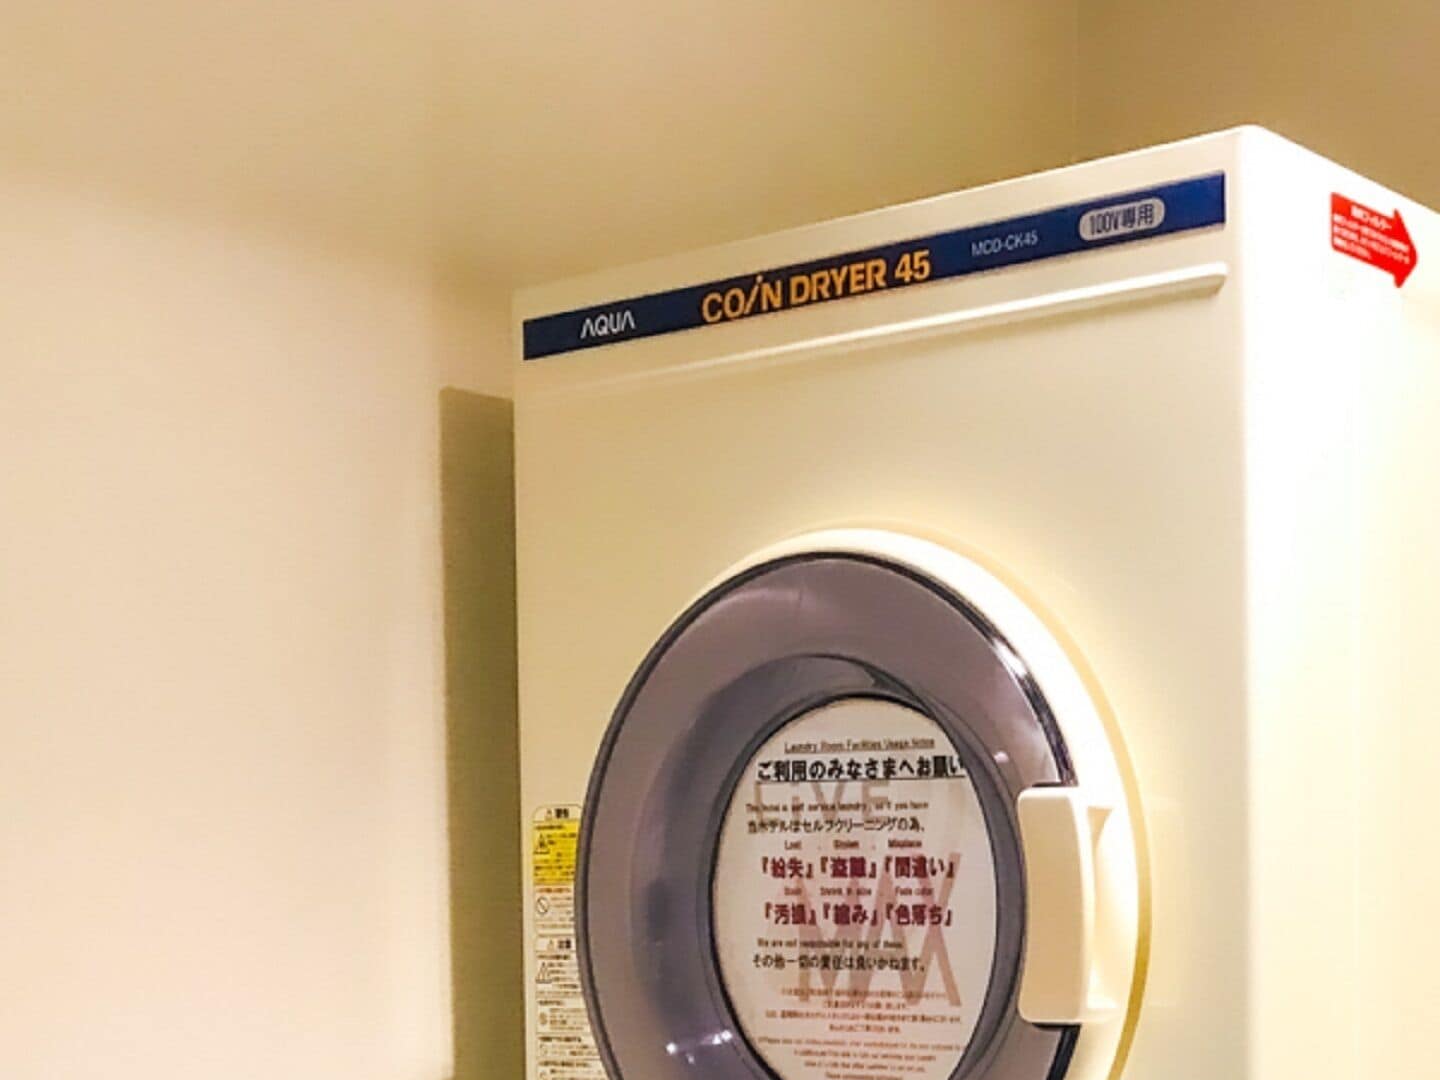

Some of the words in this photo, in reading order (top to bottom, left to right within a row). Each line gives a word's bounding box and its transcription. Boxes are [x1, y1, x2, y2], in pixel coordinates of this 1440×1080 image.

[1088, 203, 1154, 236] 100V専用
[971, 230, 1038, 257] MCD-CK45
[790, 257, 887, 305] DRYER
[893, 250, 931, 281] 45
[579, 307, 636, 340] AQUA
